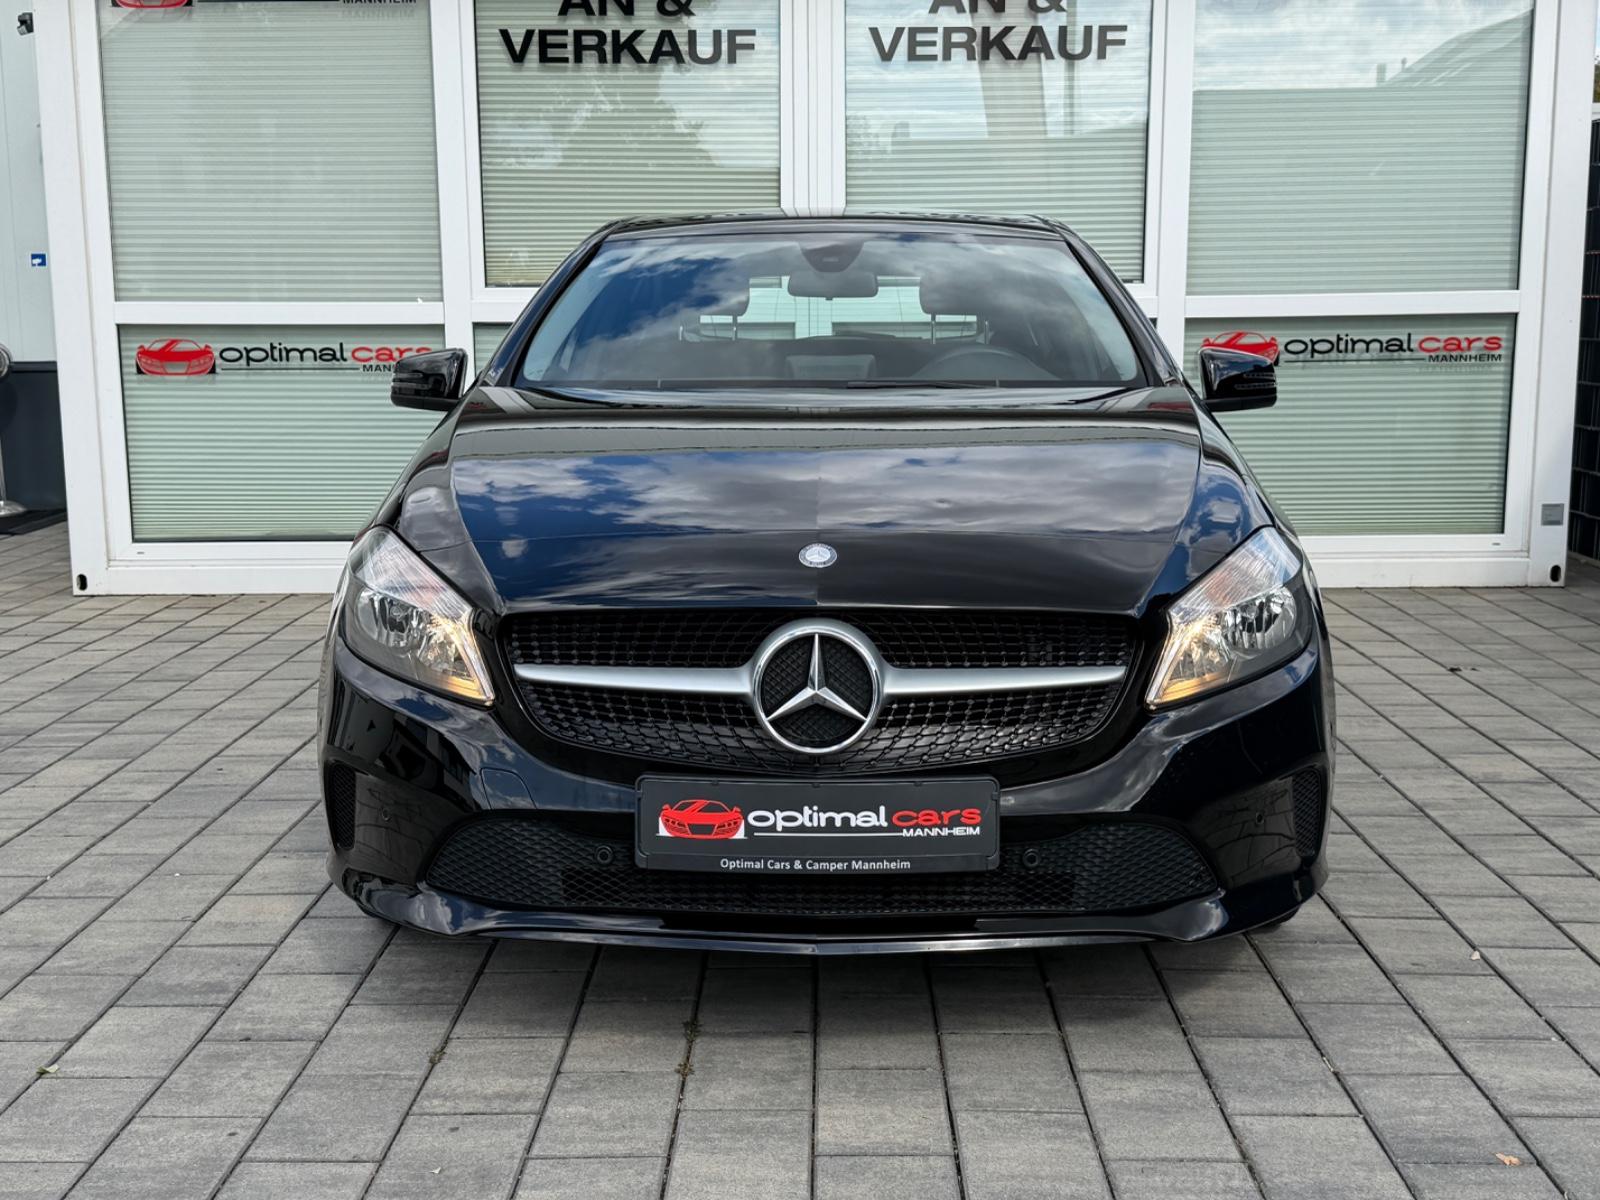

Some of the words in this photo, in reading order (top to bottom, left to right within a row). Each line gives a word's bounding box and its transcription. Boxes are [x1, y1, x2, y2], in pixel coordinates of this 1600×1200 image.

[498, 28, 757, 65] VERKAUF
[868, 25, 1128, 62] VERKAUF
[219, 342, 348, 367] optimal
[1284, 333, 1413, 358] optimal
[1419, 336, 1503, 353] cars
[1428, 354, 1502, 362] MANNHEIM
[748, 805, 888, 831] optimal
[892, 807, 982, 826] cars
[903, 826, 981, 837] MANNHEIM
[720, 858, 764, 870] Optimal
[766, 859, 792, 870] Cars
[793, 859, 803, 870] &
[805, 859, 849, 872] Camper
[851, 859, 911, 870] Mannheim
